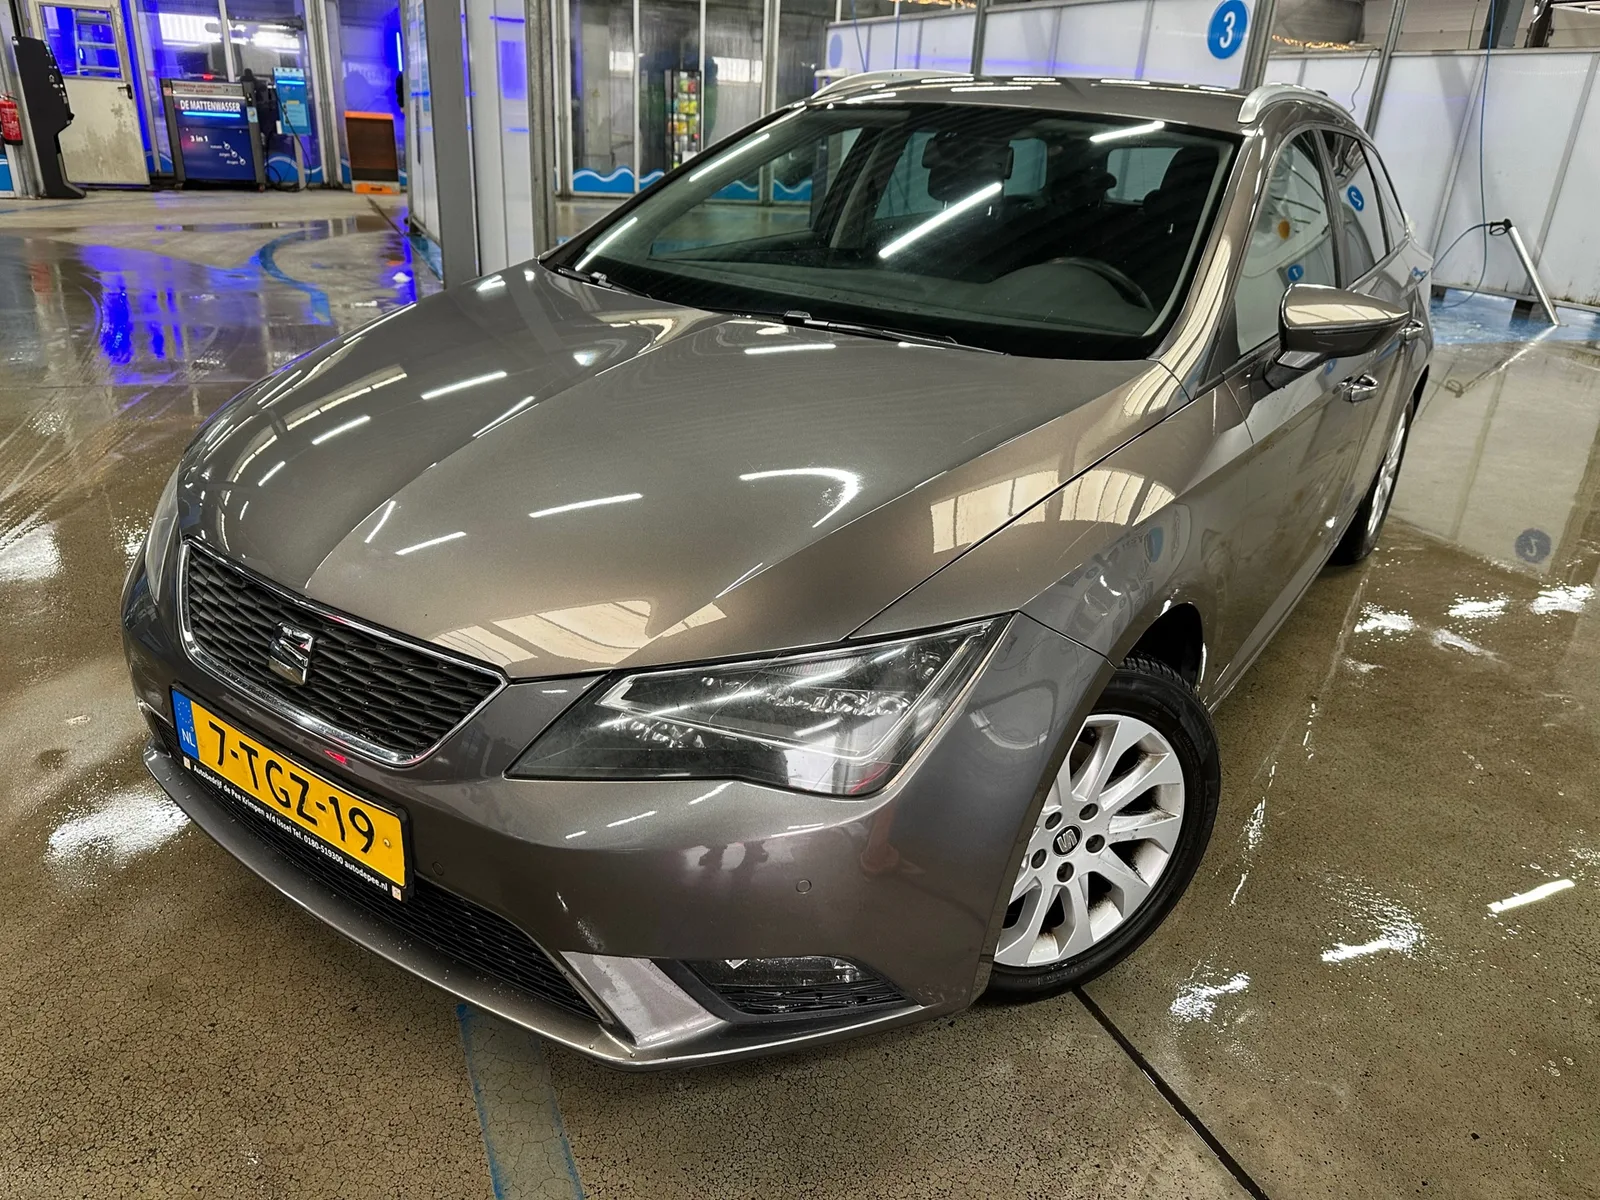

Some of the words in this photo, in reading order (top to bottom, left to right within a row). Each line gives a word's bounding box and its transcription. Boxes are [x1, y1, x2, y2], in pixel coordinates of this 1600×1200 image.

[1219, 10, 1236, 49] 3
[180, 100, 189, 110] DE
[190, 101, 241, 112] MATTENWASSER
[195, 134, 203, 142] in
[181, 728, 196, 748] NL
[208, 720, 375, 854] 7-TGZ-19
[193, 765, 222, 789] Autobedrijf
[223, 784, 231, 795] de
[231, 788, 242, 801] Pee
[242, 795, 265, 817] Krimpen
[265, 811, 276, 824] a/d
[292, 827, 304, 840] Tel.
[303, 834, 344, 865] 0180-519300
[344, 860, 388, 891] autodepee.nl
